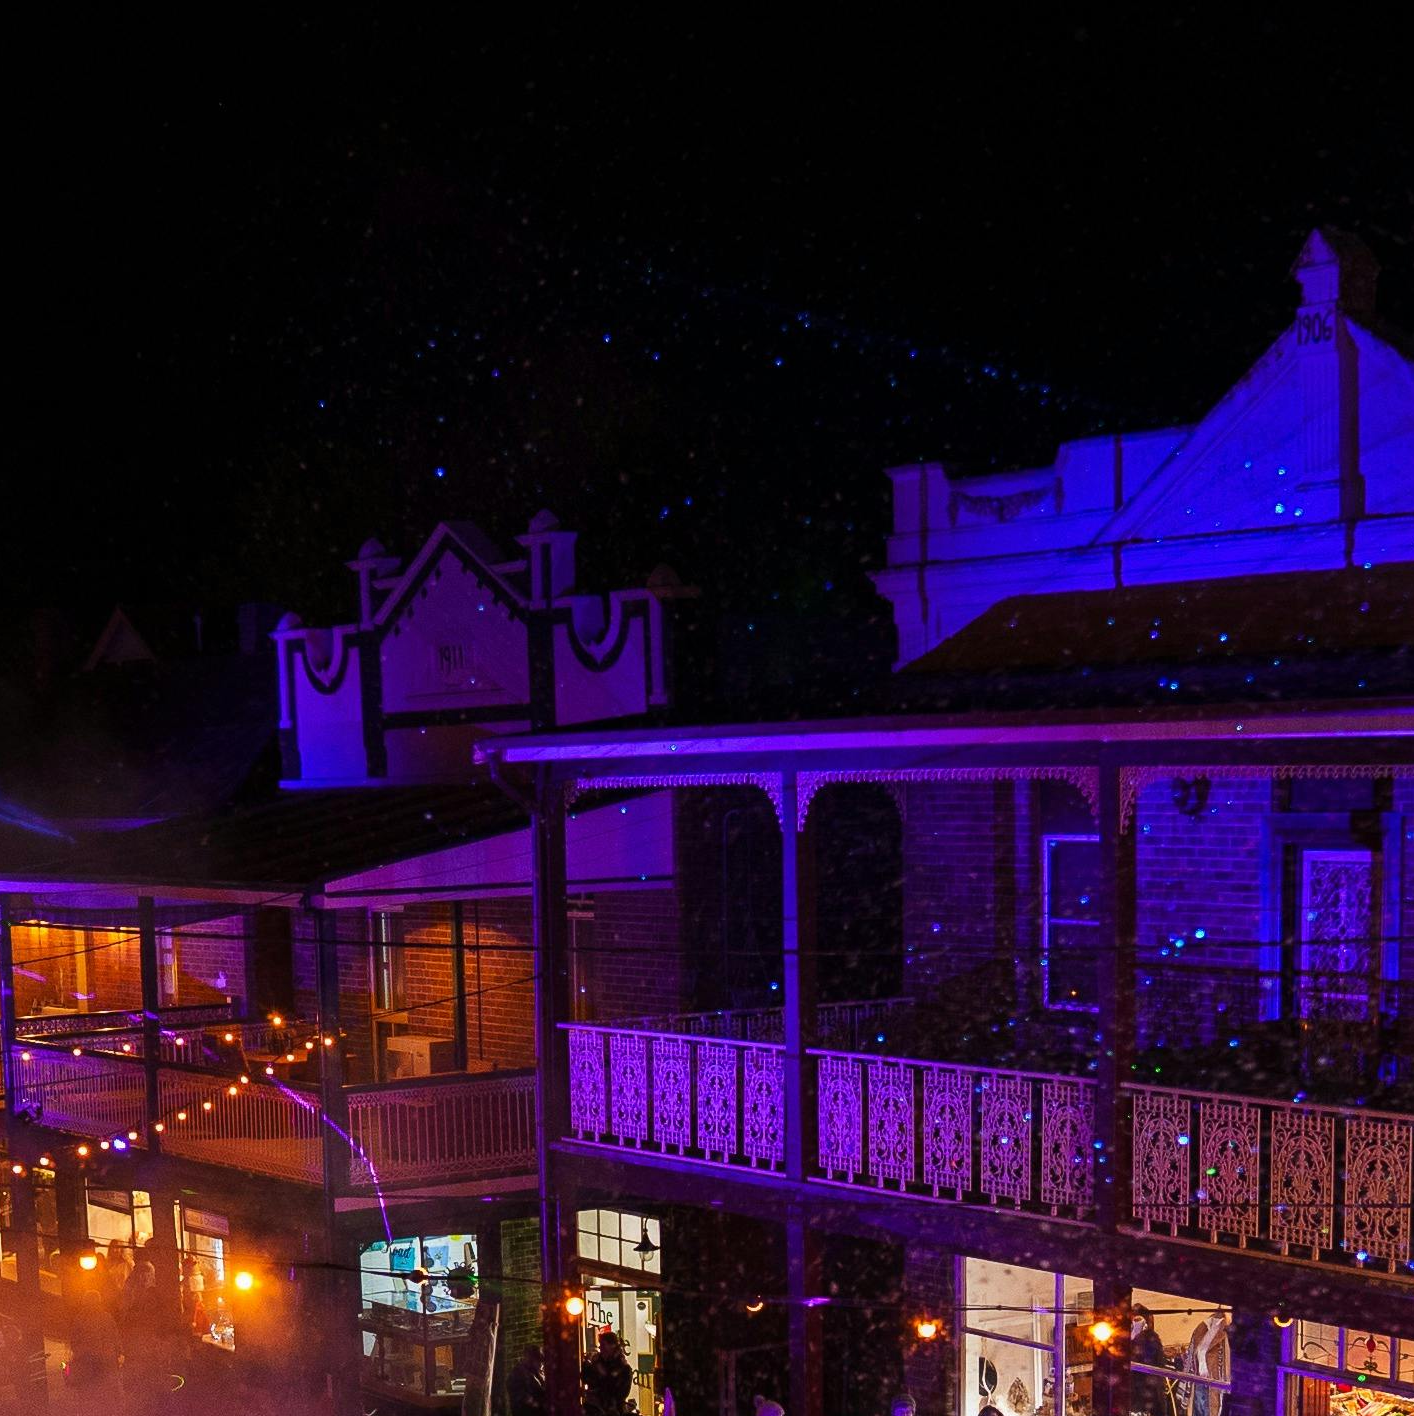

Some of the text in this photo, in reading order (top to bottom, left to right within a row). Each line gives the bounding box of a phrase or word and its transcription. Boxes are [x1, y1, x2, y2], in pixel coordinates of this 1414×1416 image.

[1297, 308, 1334, 346] 1906
[438, 644, 464, 677] 1911
[587, 1300, 613, 1325] The
